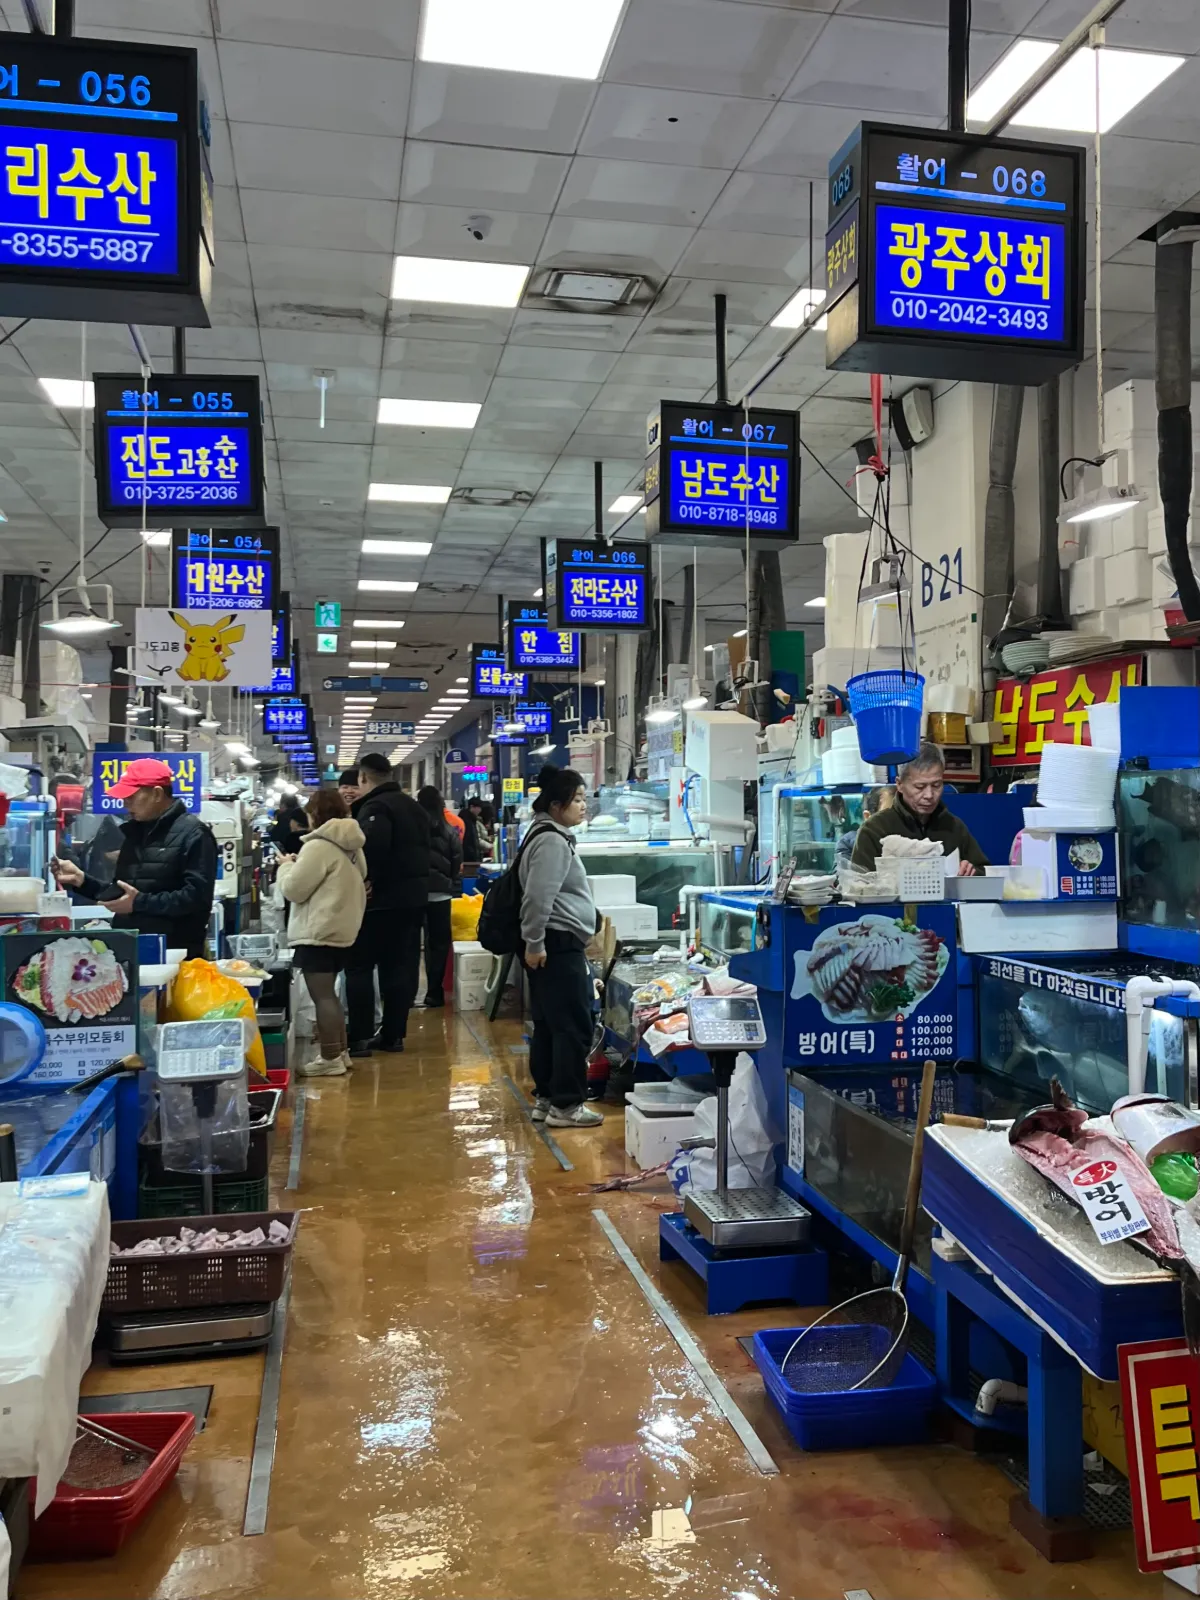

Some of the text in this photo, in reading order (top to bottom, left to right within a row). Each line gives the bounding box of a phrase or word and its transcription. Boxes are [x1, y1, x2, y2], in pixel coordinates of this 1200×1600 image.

[0, 65, 18, 96] 어
[80, 71, 151, 106] 056
[896, 153, 946, 186] 활어
[992, 166, 1046, 197] 068
[888, 222, 1051, 300] 광주상회
[892, 297, 1049, 331] 010-2042-3493
[121, 390, 159, 410] 활어
[192, 391, 233, 410] 055
[682, 418, 713, 437] 활어
[742, 424, 776, 441] 067
[680, 459, 780, 503] 남도수산
[124, 485, 238, 500] 010-3725-2036
[679, 505, 777, 525] 010-8718-4948
[234, 536, 262, 548] 054
[612, 551, 636, 563] 066
[186, 562, 265, 594] 대원수산
[922, 547, 963, 608] B21
[570, 577, 638, 606] 전라도수산
[570, 608, 638, 619] 010-5356-1802
[367, 722, 402, 734] 화장실
[989, 960, 1026, 983] 최선을
[917, 1014, 953, 1024] 80,000
[911, 1025, 953, 1035] 100,000
[911, 1036, 953, 1046] 120,000
[911, 1047, 953, 1057] 140,000
